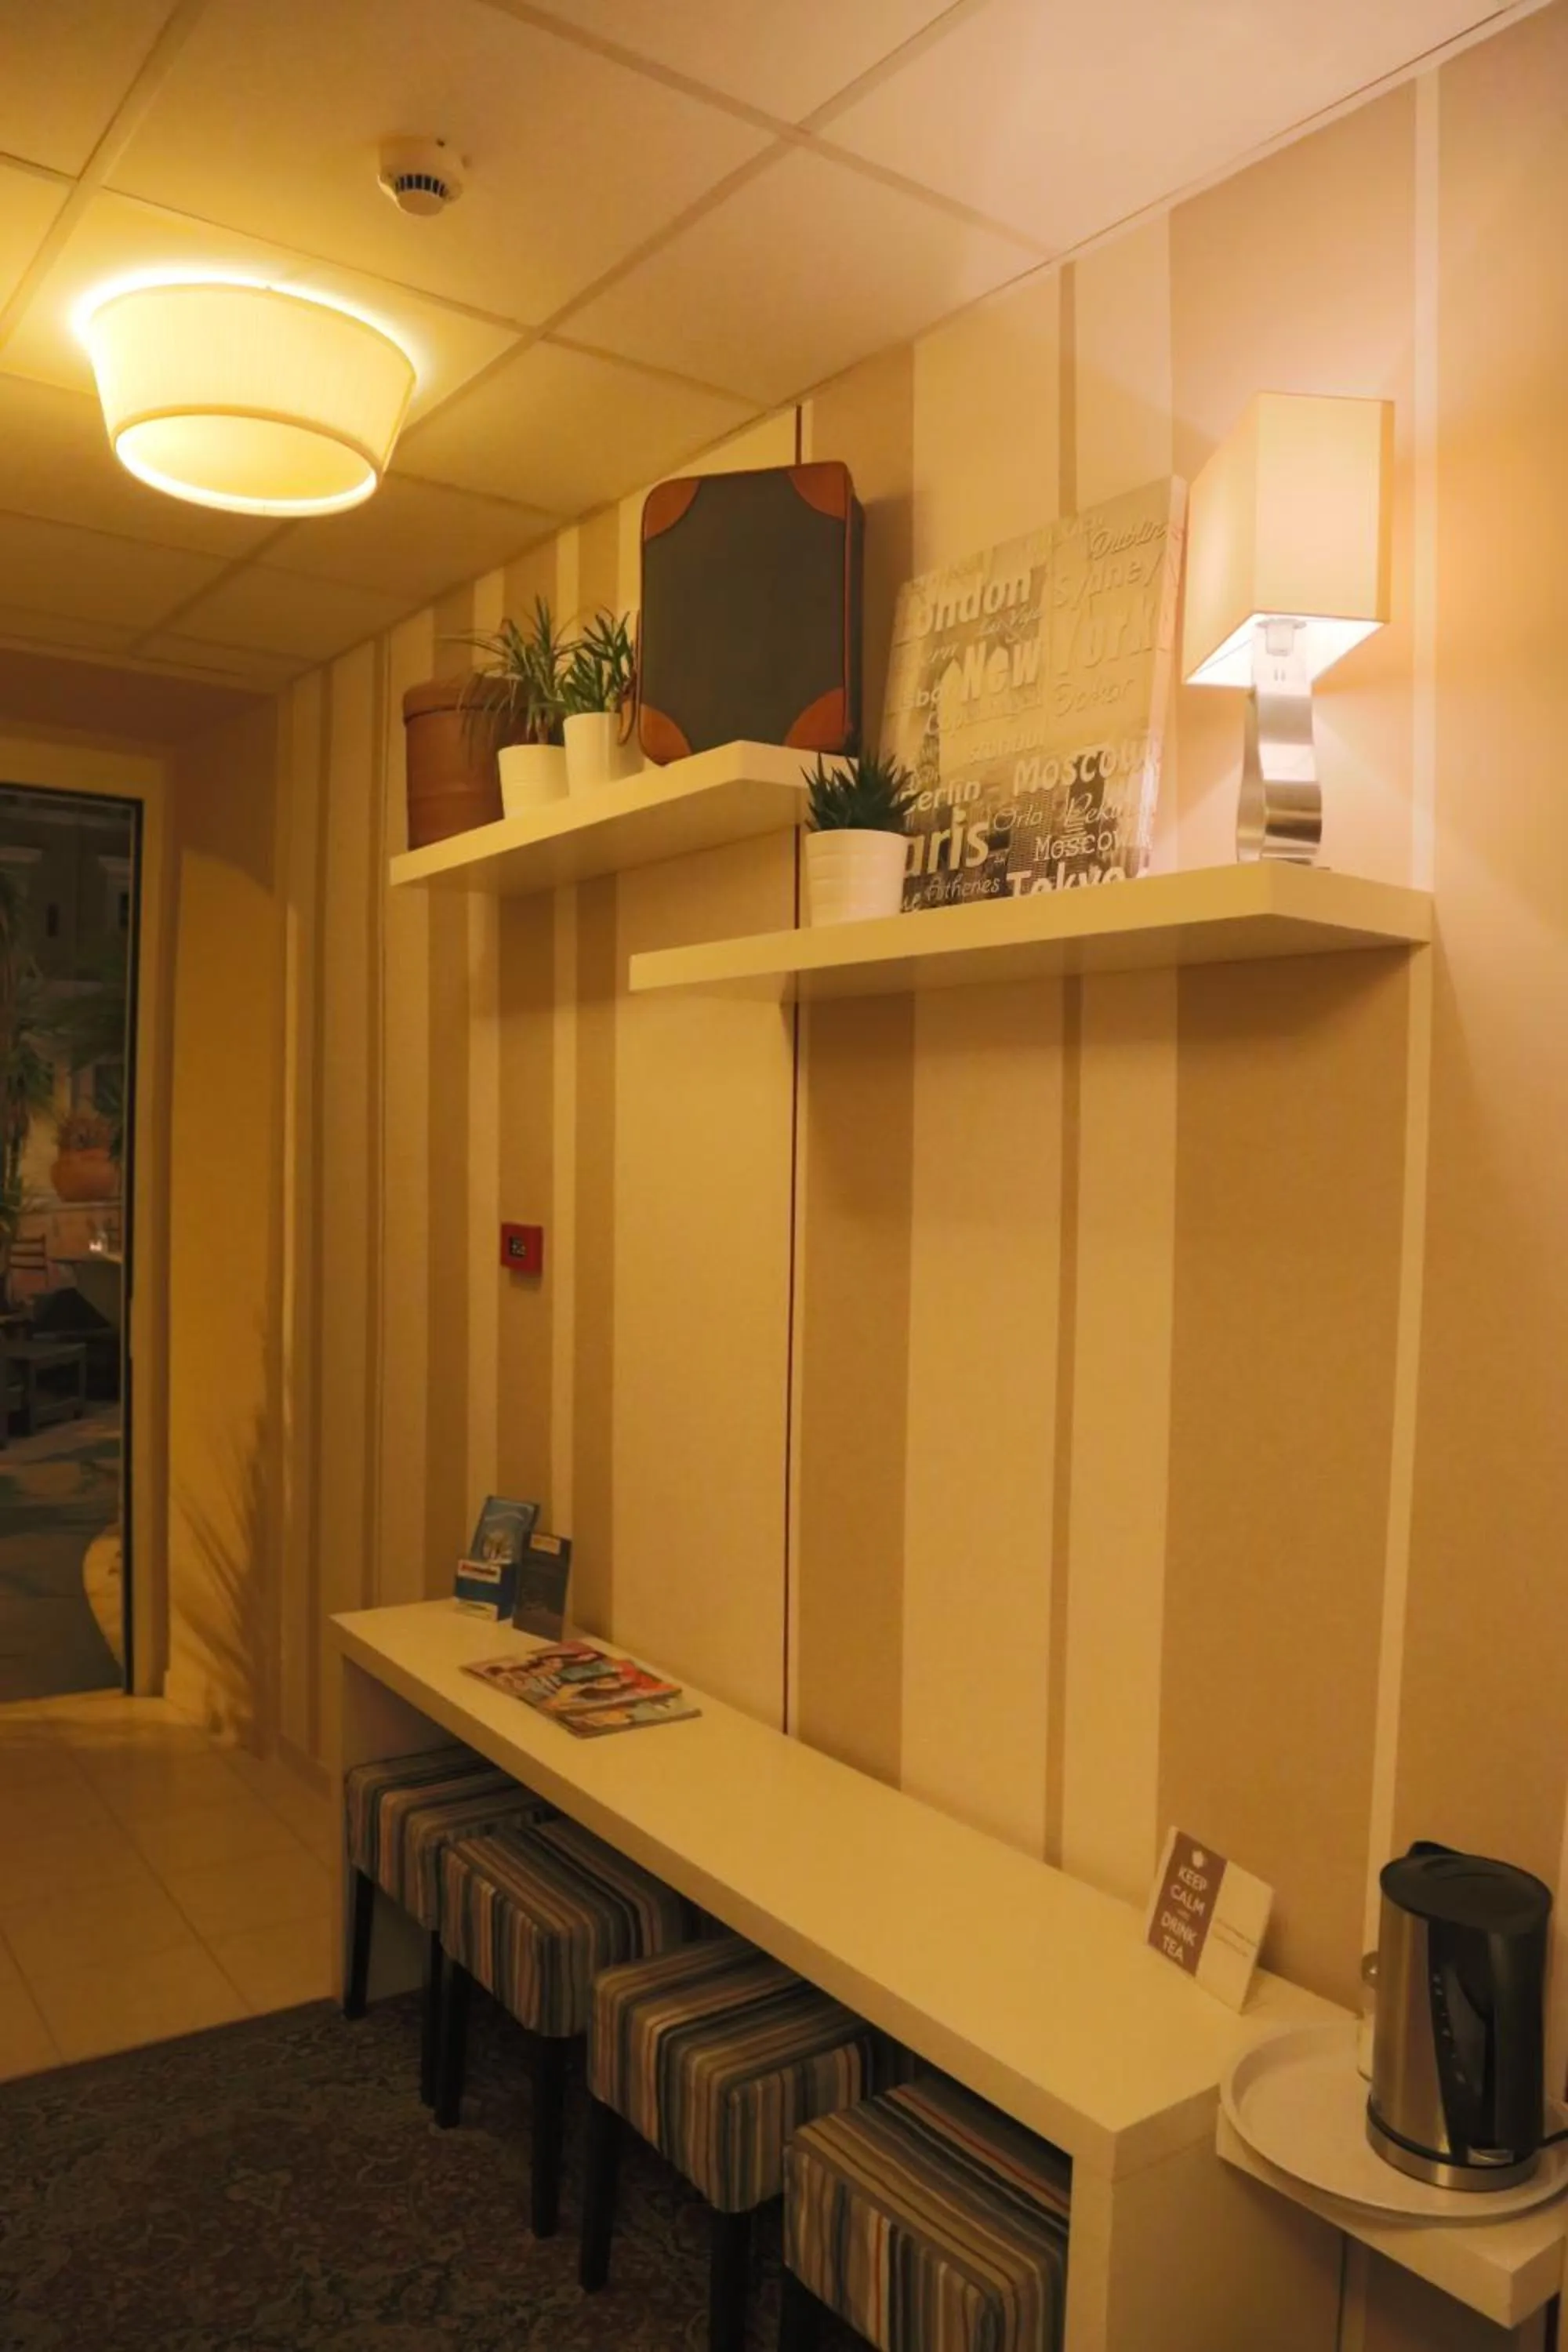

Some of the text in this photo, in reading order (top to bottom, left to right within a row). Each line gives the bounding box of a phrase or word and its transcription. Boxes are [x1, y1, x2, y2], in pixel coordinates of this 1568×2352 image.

[1052, 550, 1165, 612] Sydney
[895, 569, 1031, 648] ondon
[903, 806, 989, 877] aris
[1178, 1866, 1208, 1892] KEEP
[1170, 1884, 1206, 1917] CALM
[1160, 1911, 1198, 1947] DRINK
[1163, 1935, 1185, 1964] TEA
